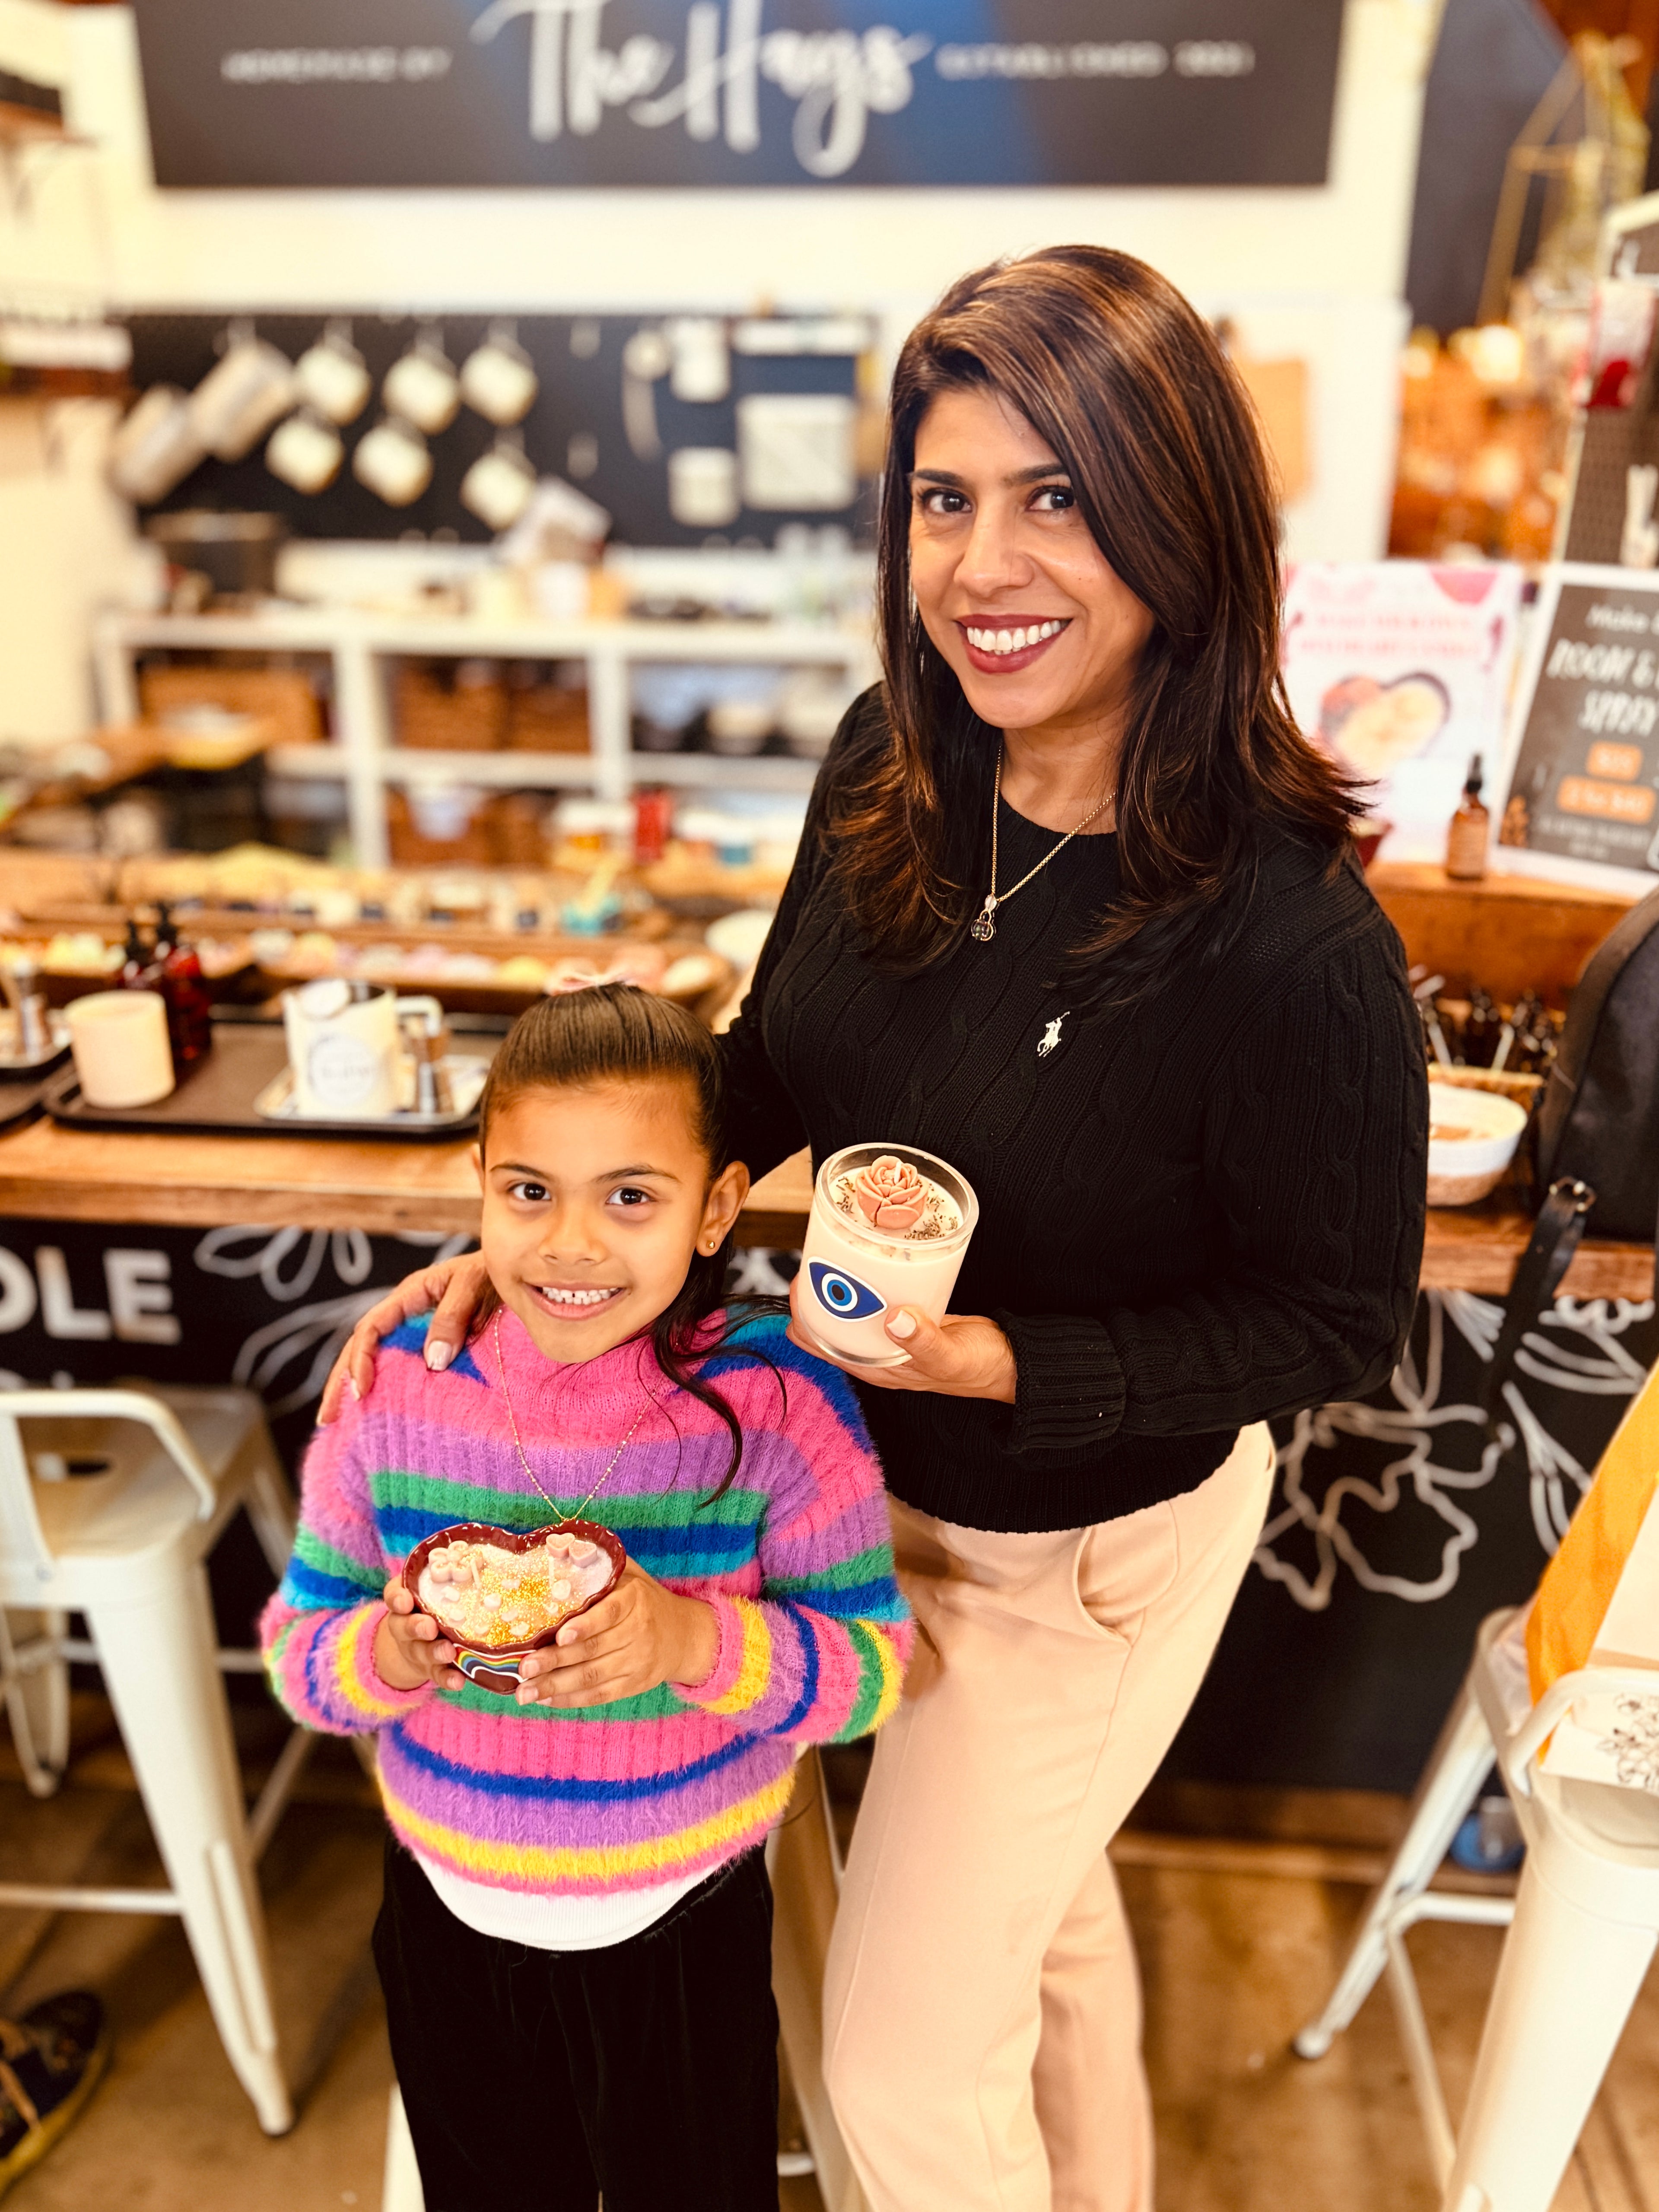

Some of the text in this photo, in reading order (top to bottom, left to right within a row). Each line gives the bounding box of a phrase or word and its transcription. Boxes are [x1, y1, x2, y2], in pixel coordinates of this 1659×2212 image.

[472, 0, 675, 142] The
[934, 42, 1169, 81] ESTABLISHED
[1584, 604, 1650, 634] Make
[1546, 638, 1636, 685] ROOM
